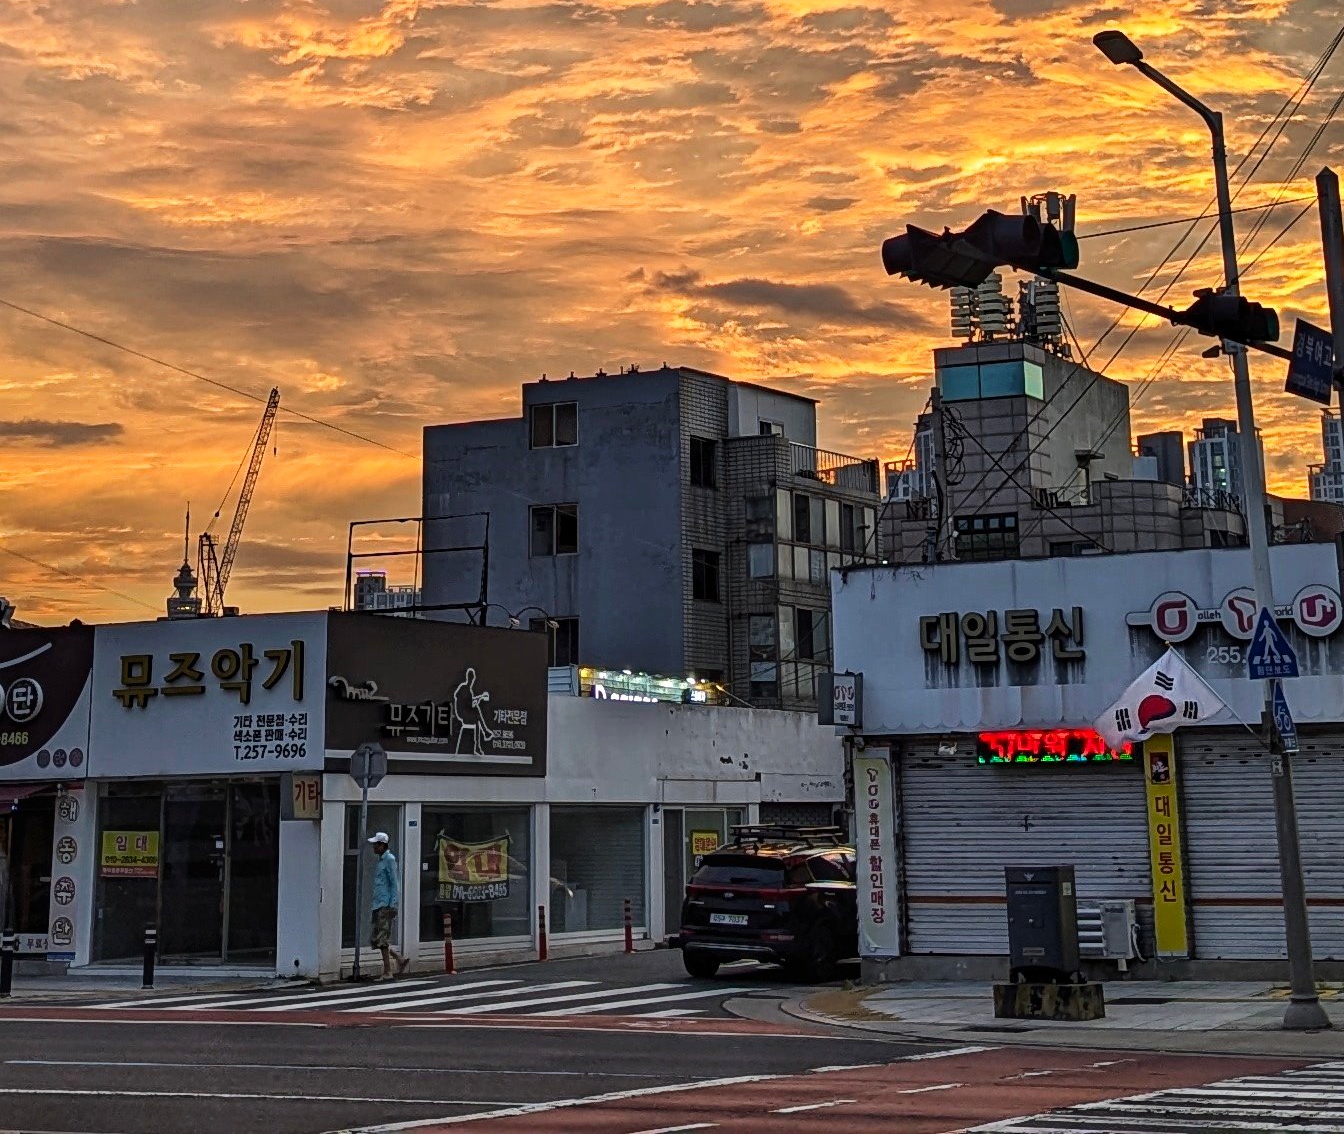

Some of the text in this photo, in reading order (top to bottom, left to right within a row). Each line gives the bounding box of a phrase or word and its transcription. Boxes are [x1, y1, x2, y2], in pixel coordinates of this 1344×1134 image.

[1296, 332, 1332, 367] 경북여고
[1197, 608, 1222, 620] olleh
[919, 605, 1087, 665] 대일통신
[112, 639, 306, 709] 뮤즈악기
[233, 716, 253, 729] 기타
[385, 702, 454, 737] 뮤즈기타
[233, 731, 262, 743] 색소폰
[233, 743, 307, 761] T.257-9696
[294, 781, 321, 805] 기타
[115, 835, 147, 852] 임대
[1154, 795, 1178, 905] 대일통신
[869, 811, 886, 925] 휴대폰 할인매장
